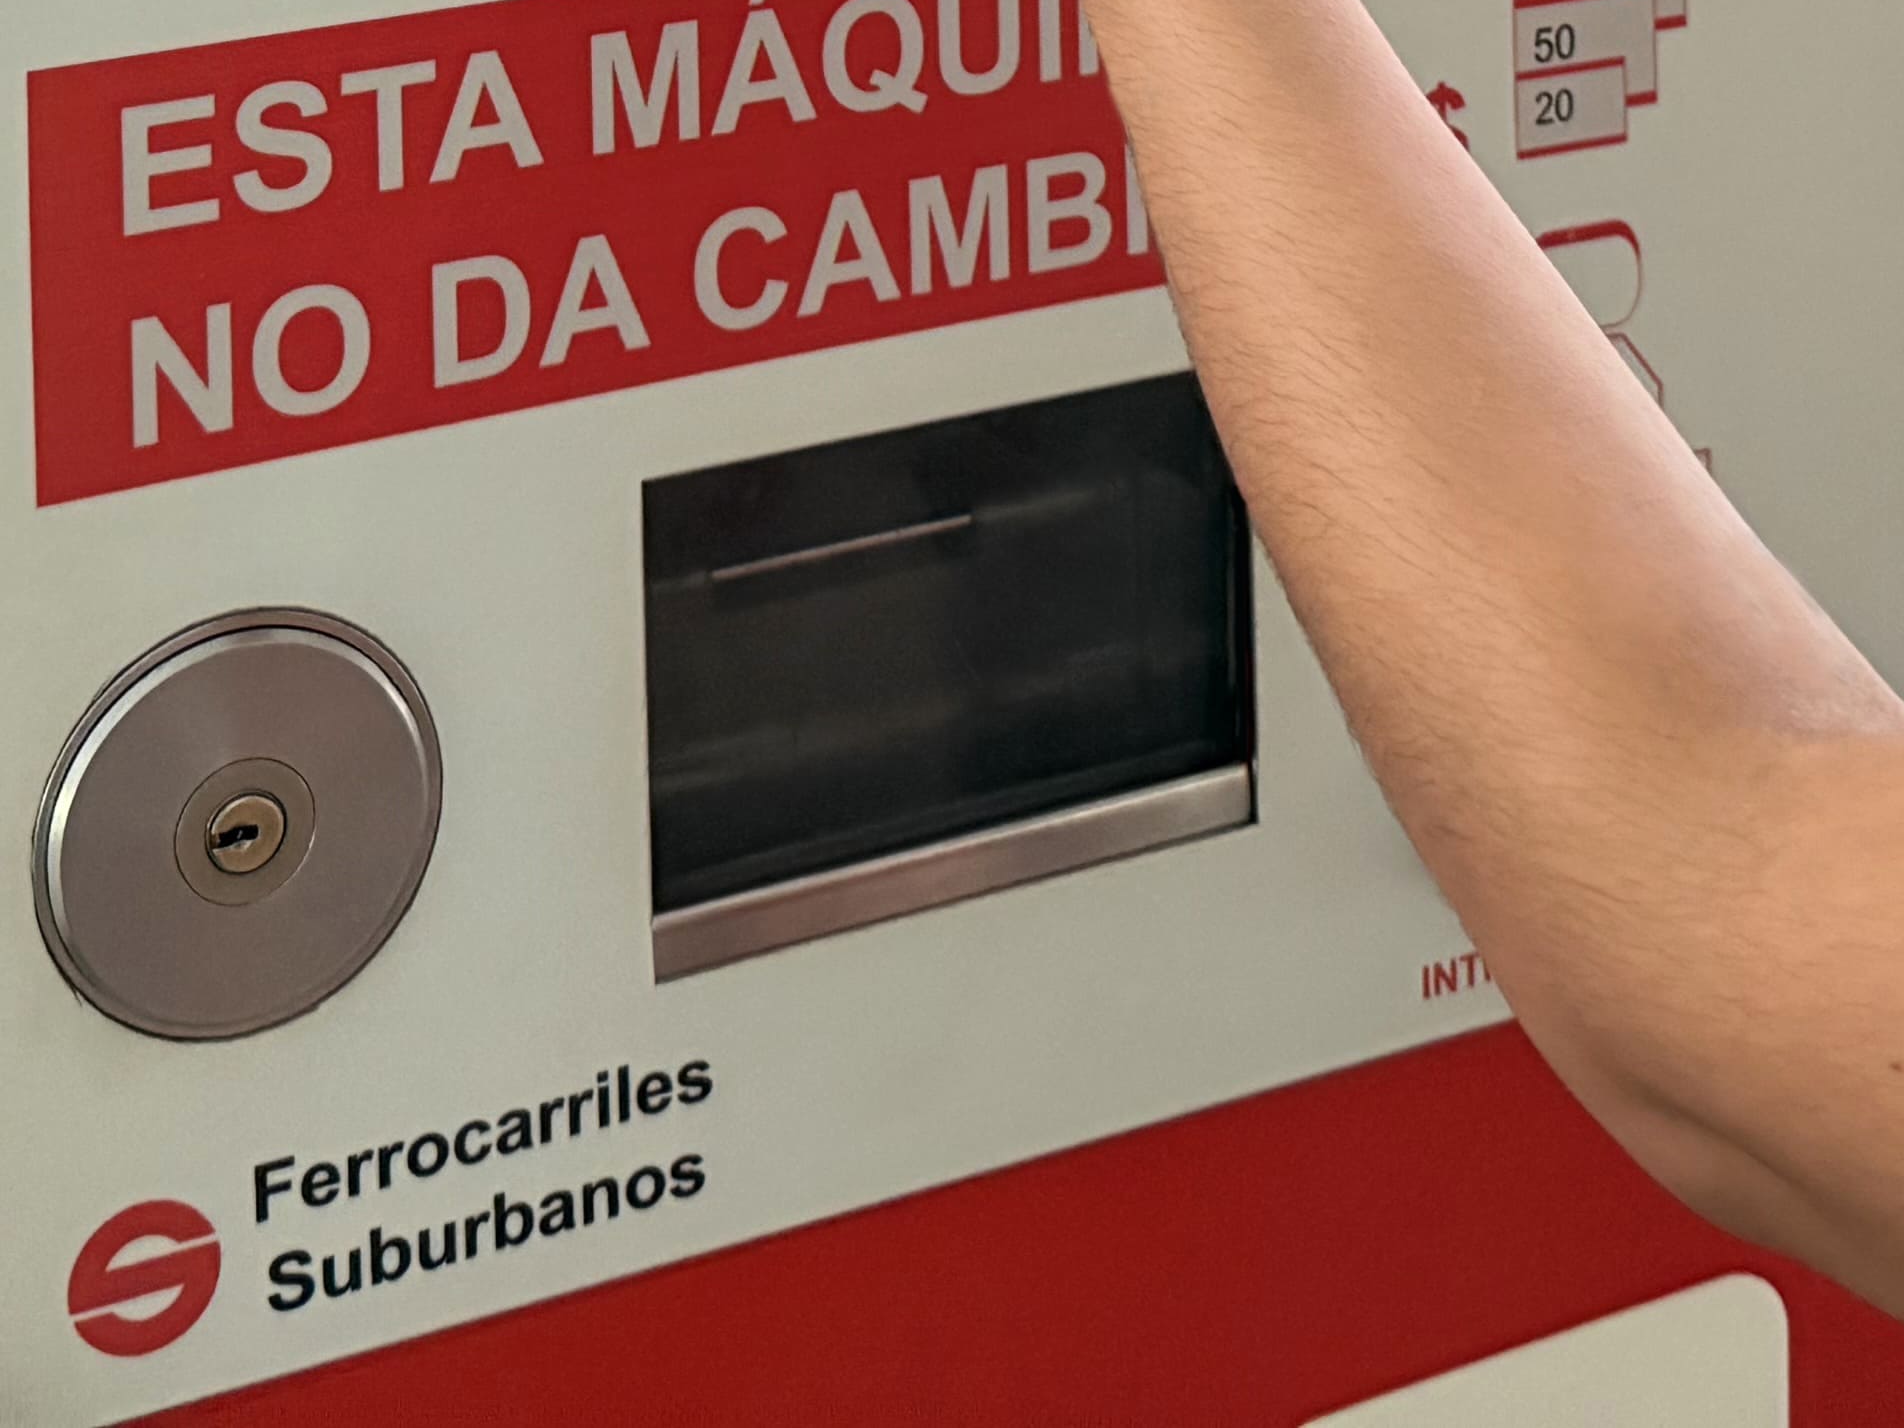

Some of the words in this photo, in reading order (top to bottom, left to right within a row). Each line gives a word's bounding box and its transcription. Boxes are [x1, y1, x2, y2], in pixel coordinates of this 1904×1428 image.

[1535, 24, 1574, 63] 50
[1536, 89, 1573, 125] 20
[121, 51, 543, 236] ESTA
[132, 285, 370, 448] NO
[432, 235, 650, 388] DA
[694, 132, 1164, 331] CAMBI
[254, 1061, 712, 1223] Ferrocarriles
[268, 1155, 705, 1311] Suburbanos
